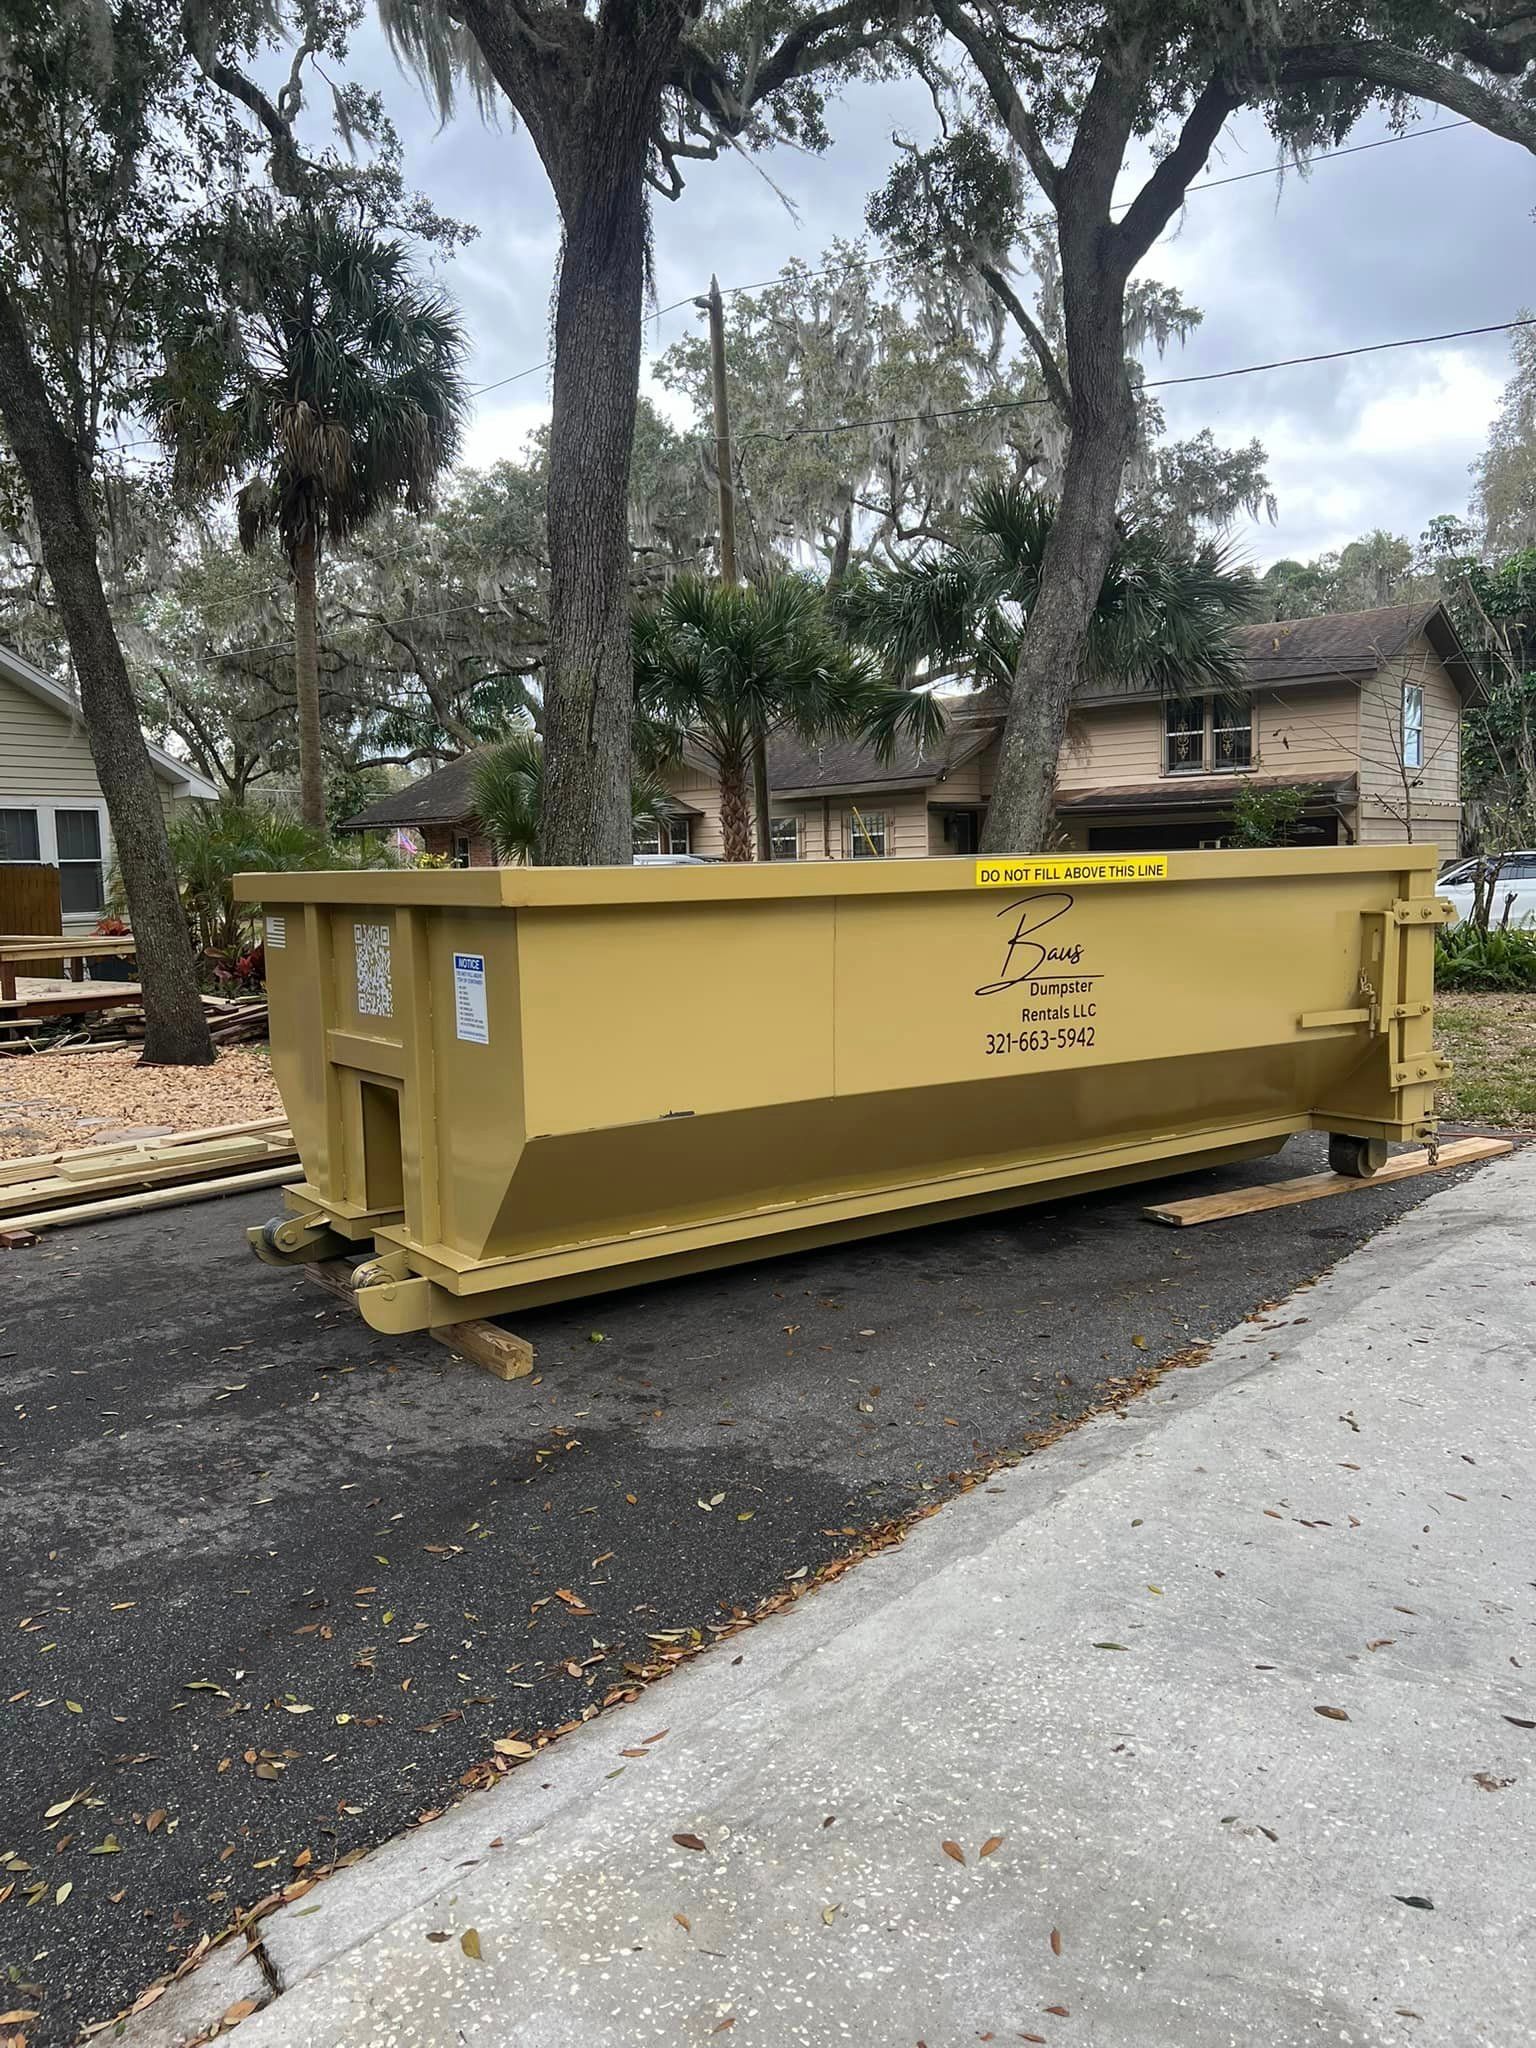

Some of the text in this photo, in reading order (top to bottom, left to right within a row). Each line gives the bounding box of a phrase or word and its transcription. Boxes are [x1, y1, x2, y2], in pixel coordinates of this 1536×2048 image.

[981, 863, 1164, 882] DO NOT FILL ABOVE THIS LINE
[975, 892, 1085, 995] Baus
[458, 958, 480, 970] NOTICE
[1030, 981, 1093, 998] Dumpster
[1021, 1003, 1097, 1022] Rentals LLC
[985, 1026, 1096, 1055] 321-663-5942
